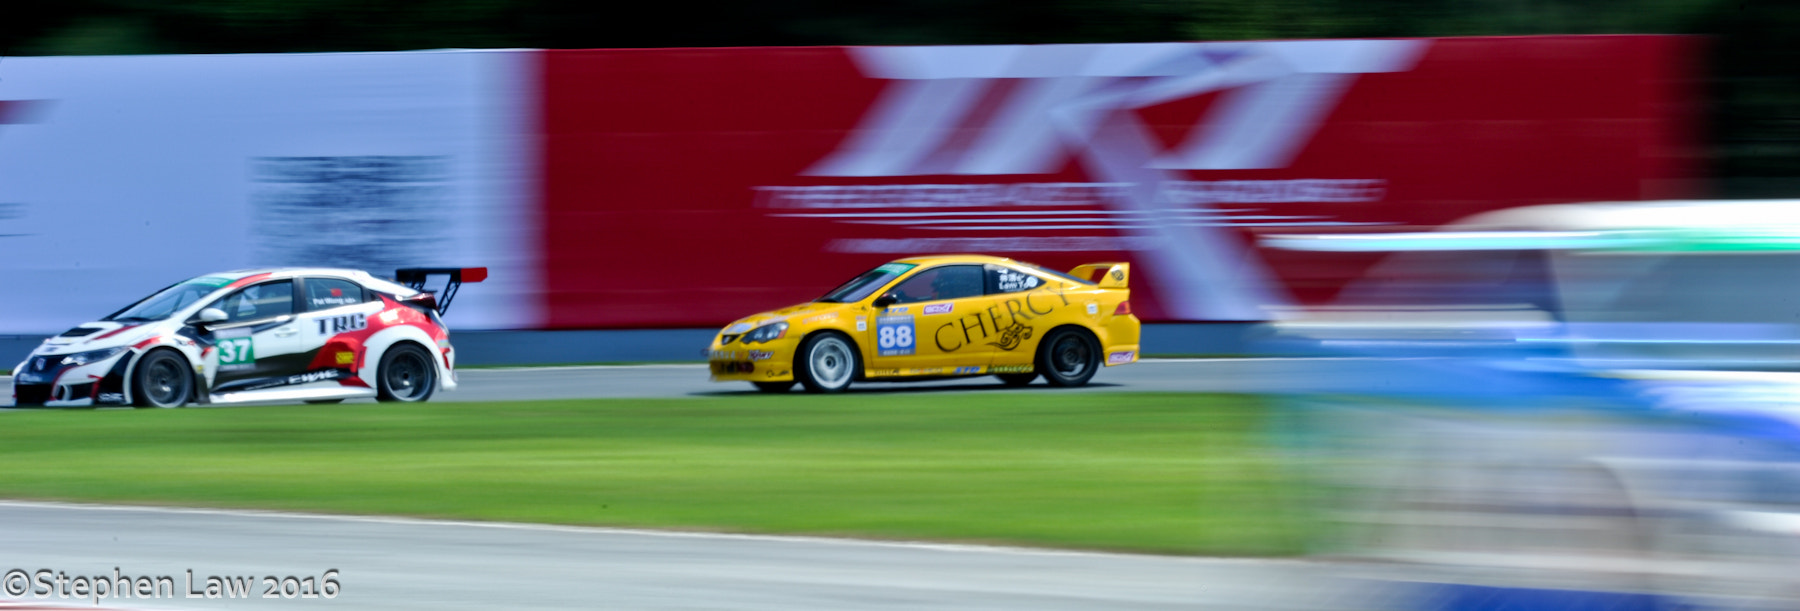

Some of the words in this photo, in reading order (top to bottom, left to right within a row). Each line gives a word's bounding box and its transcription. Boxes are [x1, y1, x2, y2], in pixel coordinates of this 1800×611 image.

[313, 312, 367, 335] TRG
[934, 282, 1071, 353] CHERCY
[880, 325, 913, 348] 88
[218, 339, 251, 363] 37
